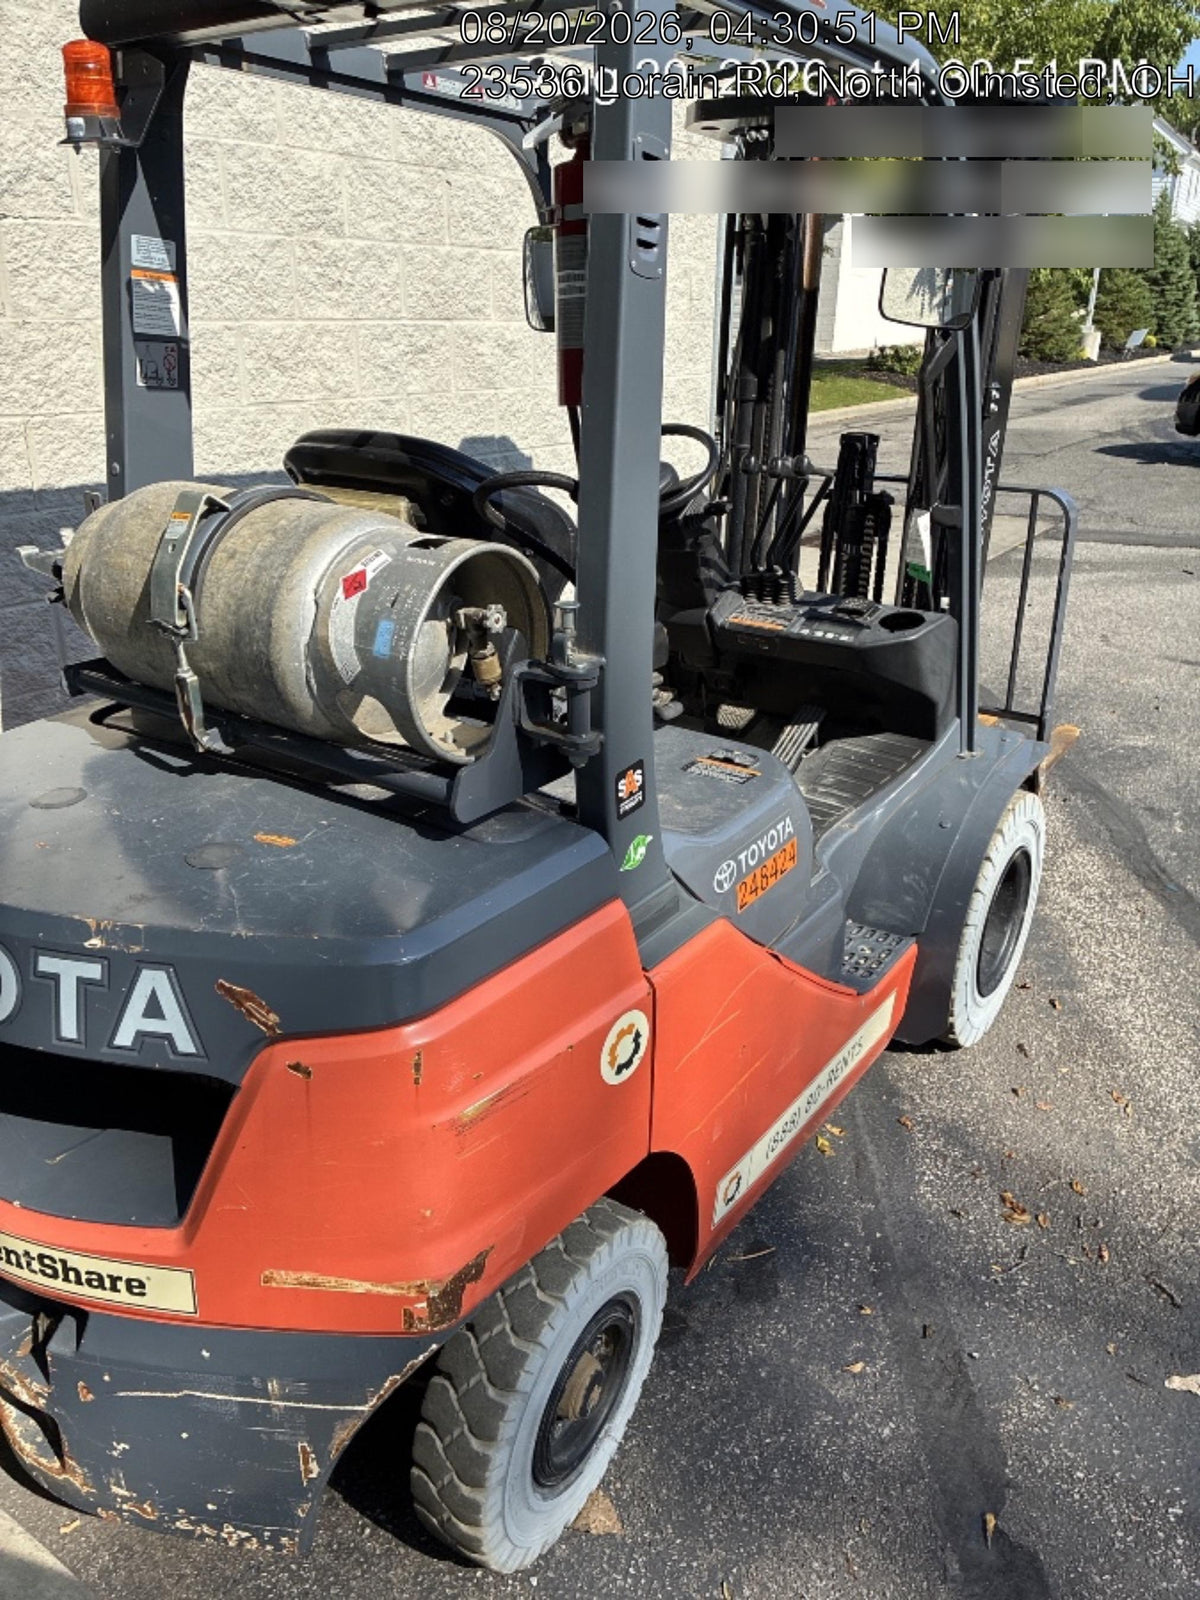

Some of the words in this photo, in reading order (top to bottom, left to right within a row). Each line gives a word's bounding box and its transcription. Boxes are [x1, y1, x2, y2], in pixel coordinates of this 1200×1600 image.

[618, 769, 643, 799] SAS
[738, 815, 794, 874] TOYOTA
[739, 841, 796, 911] 248424
[0, 1245, 147, 1297] ntShare
